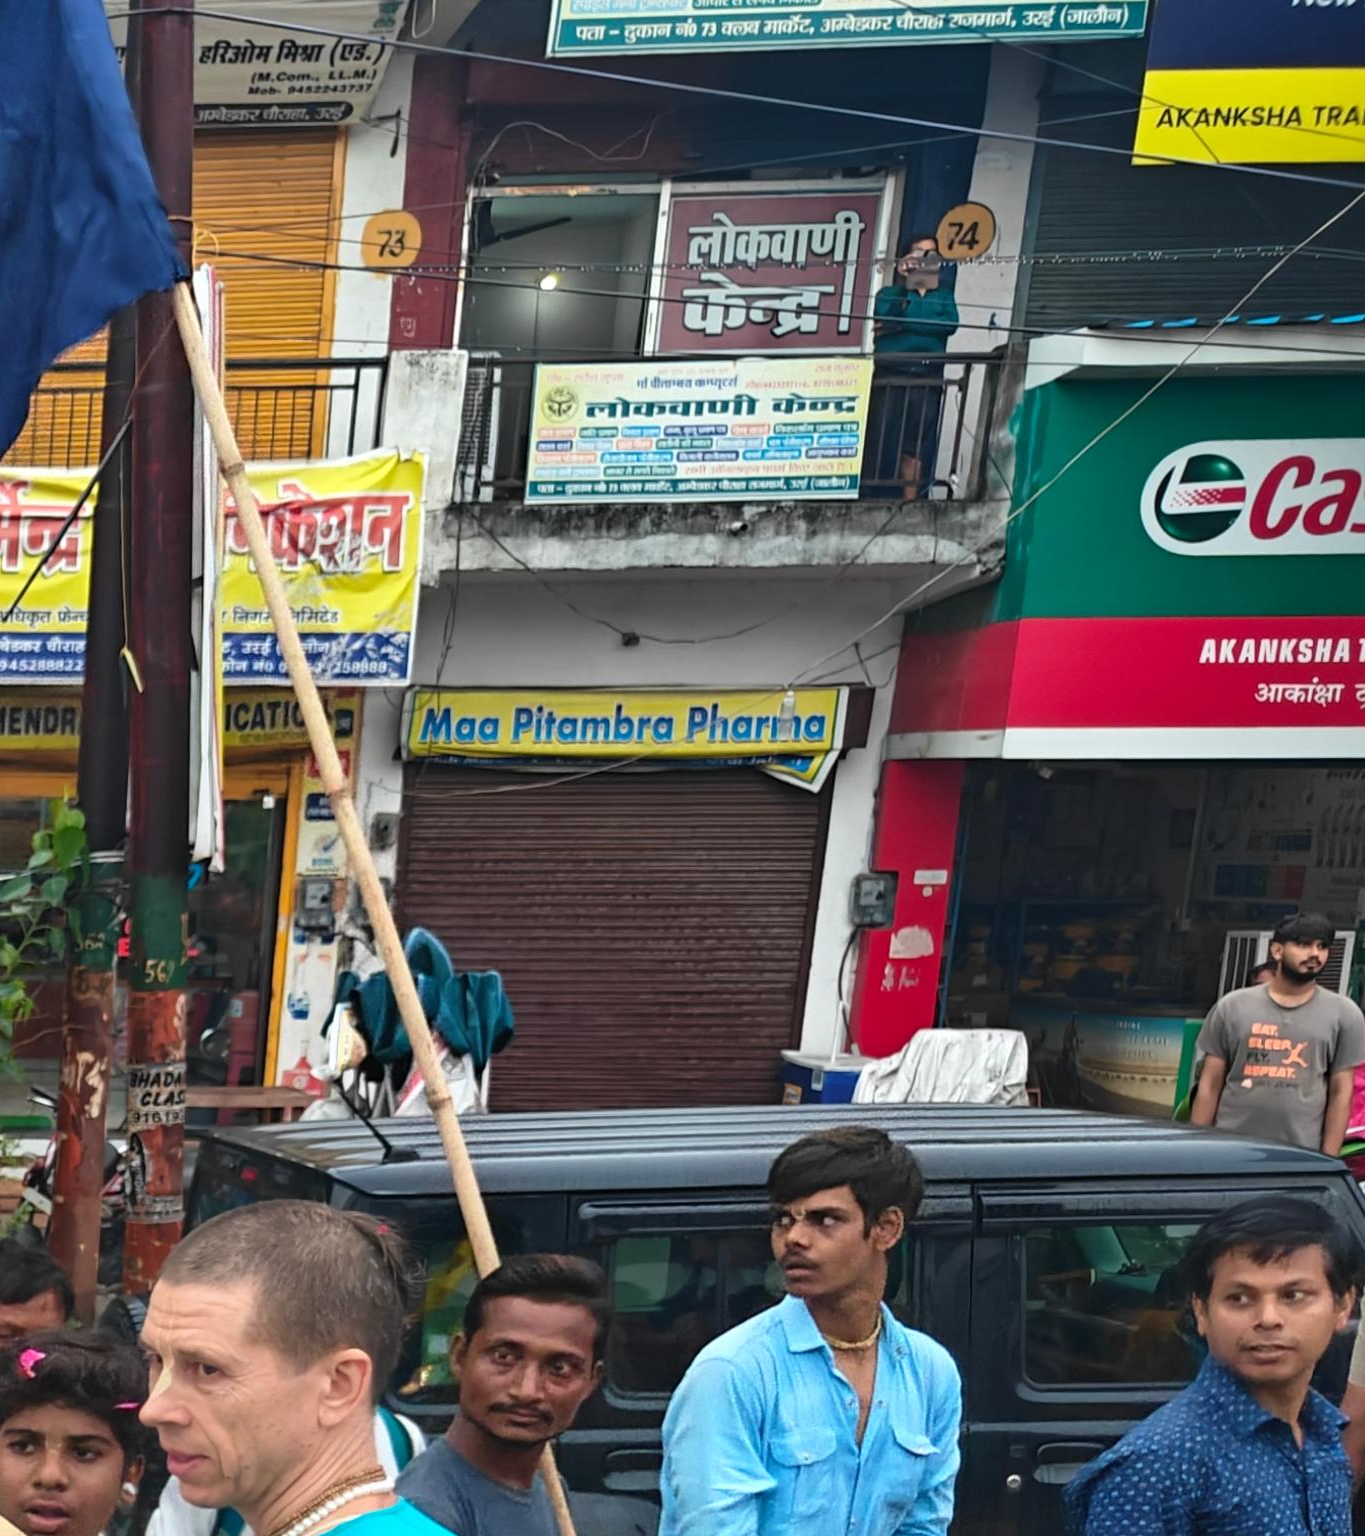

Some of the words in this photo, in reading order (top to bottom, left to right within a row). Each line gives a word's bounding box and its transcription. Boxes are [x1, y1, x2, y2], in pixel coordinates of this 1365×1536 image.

[576, 25, 606, 41] पता
[624, 23, 673, 44] दुकान
[701, 22, 717, 37] 73
[198, 38, 274, 64] हरिओम
[275, 37, 325, 64] मिश्रा
[286, 83, 374, 95] 9452243737
[1155, 106, 1303, 129] AKANKSHA
[376, 228, 408, 257] 73
[947, 221, 981, 251] 74
[681, 272, 836, 337] केन्द्र
[585, 394, 761, 419] लोकवाणी
[771, 392, 861, 415] केन्द्र
[1199, 638, 1350, 664] AKANKSHA
[1254, 677, 1343, 707] आकांक्षा
[419, 705, 499, 743] Maa
[510, 703, 674, 744] Pitambra
